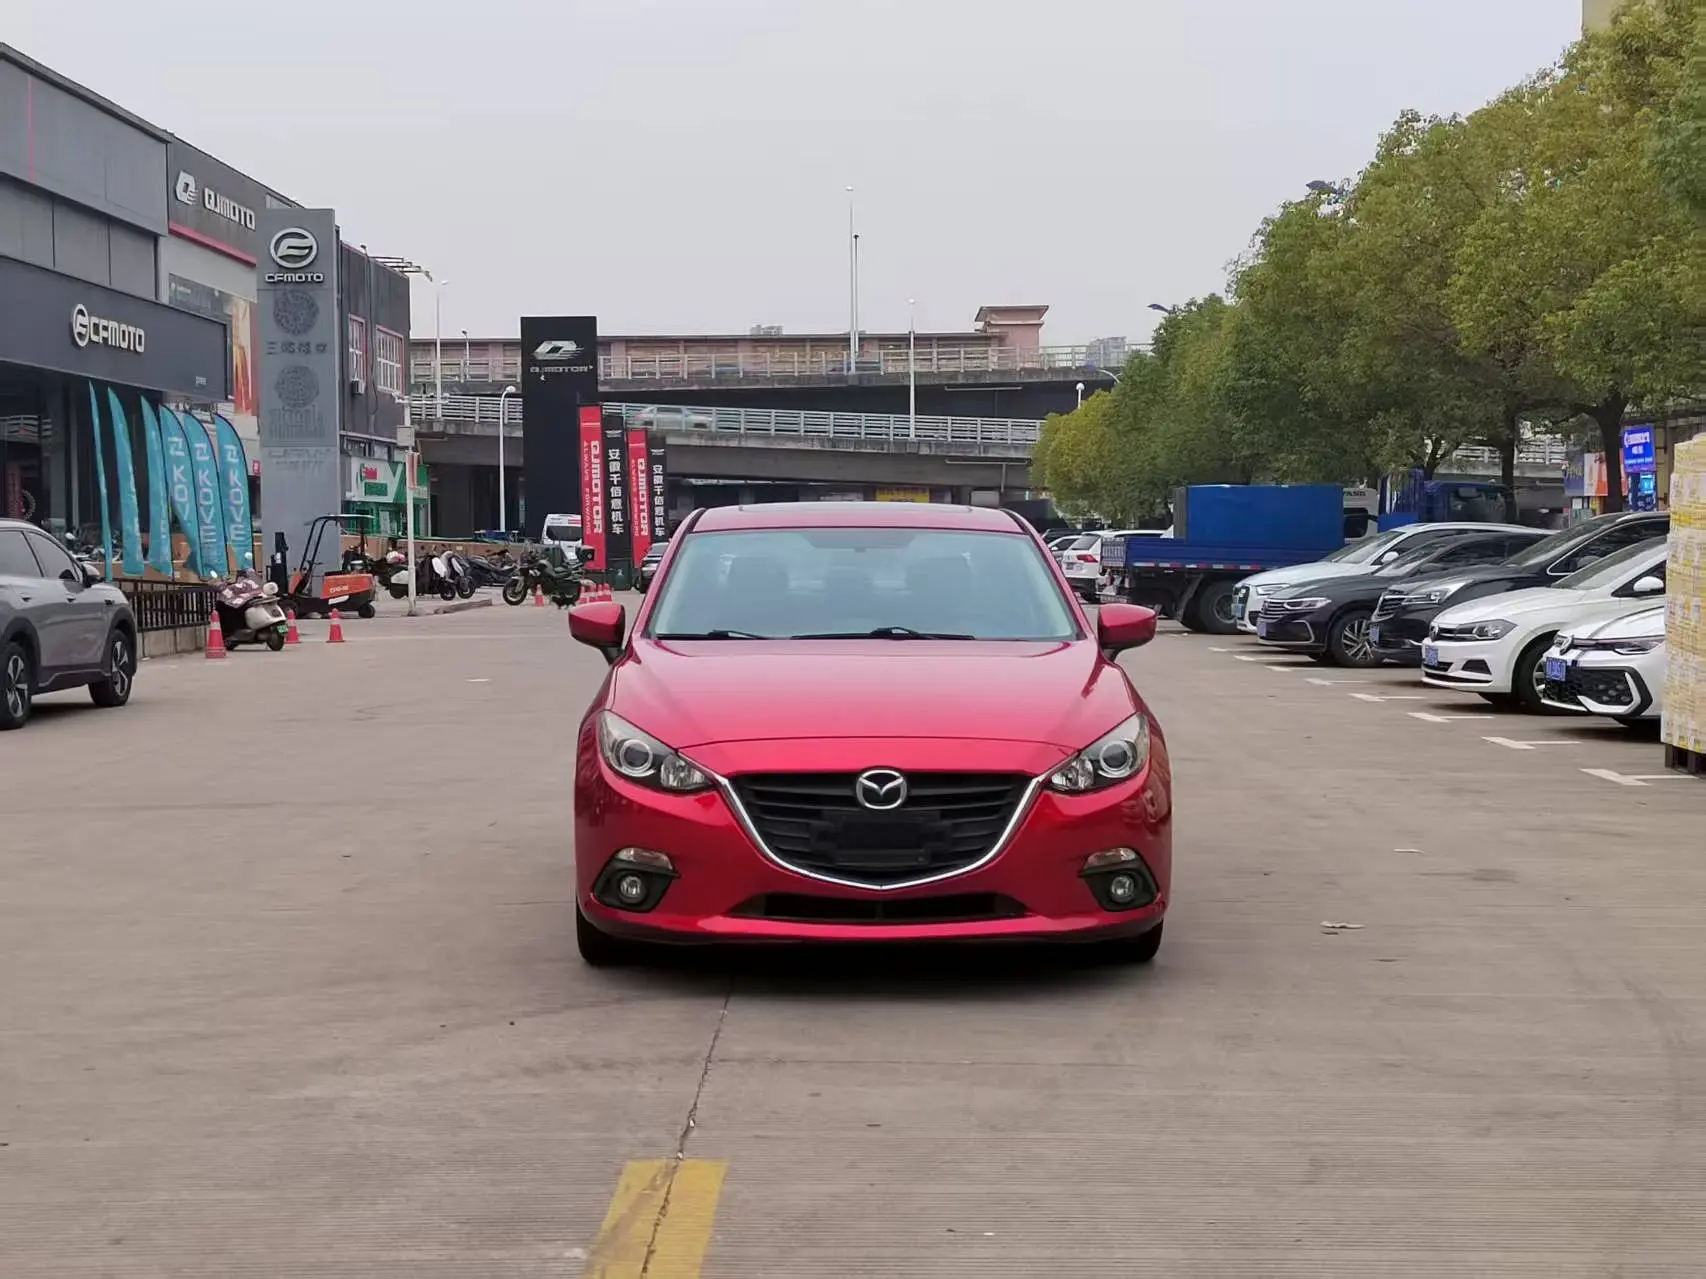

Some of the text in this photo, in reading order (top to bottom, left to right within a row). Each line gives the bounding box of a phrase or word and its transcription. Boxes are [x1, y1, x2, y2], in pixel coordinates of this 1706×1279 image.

[265, 273, 324, 283] CFMOTO
[90, 316, 145, 353] CFMOTO
[198, 469, 217, 543] KOVE
[228, 469, 246, 542] KOVE
[590, 440, 603, 534] QJMOTOR
